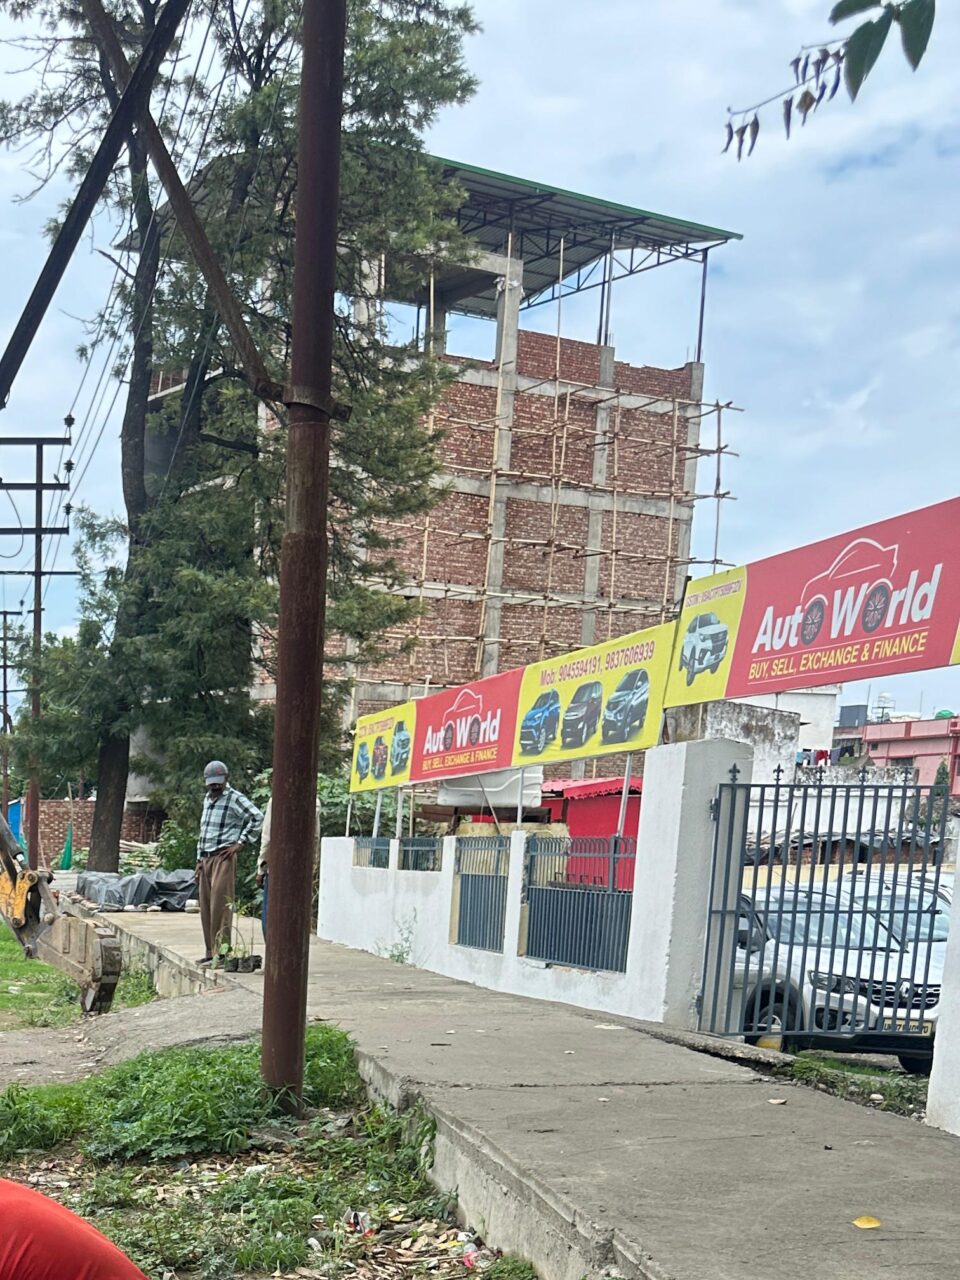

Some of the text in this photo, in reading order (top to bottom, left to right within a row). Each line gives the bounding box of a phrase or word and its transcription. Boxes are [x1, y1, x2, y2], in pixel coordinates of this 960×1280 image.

[749, 632, 929, 680] BUY, SELL, EXCHANGE & FINANCE
